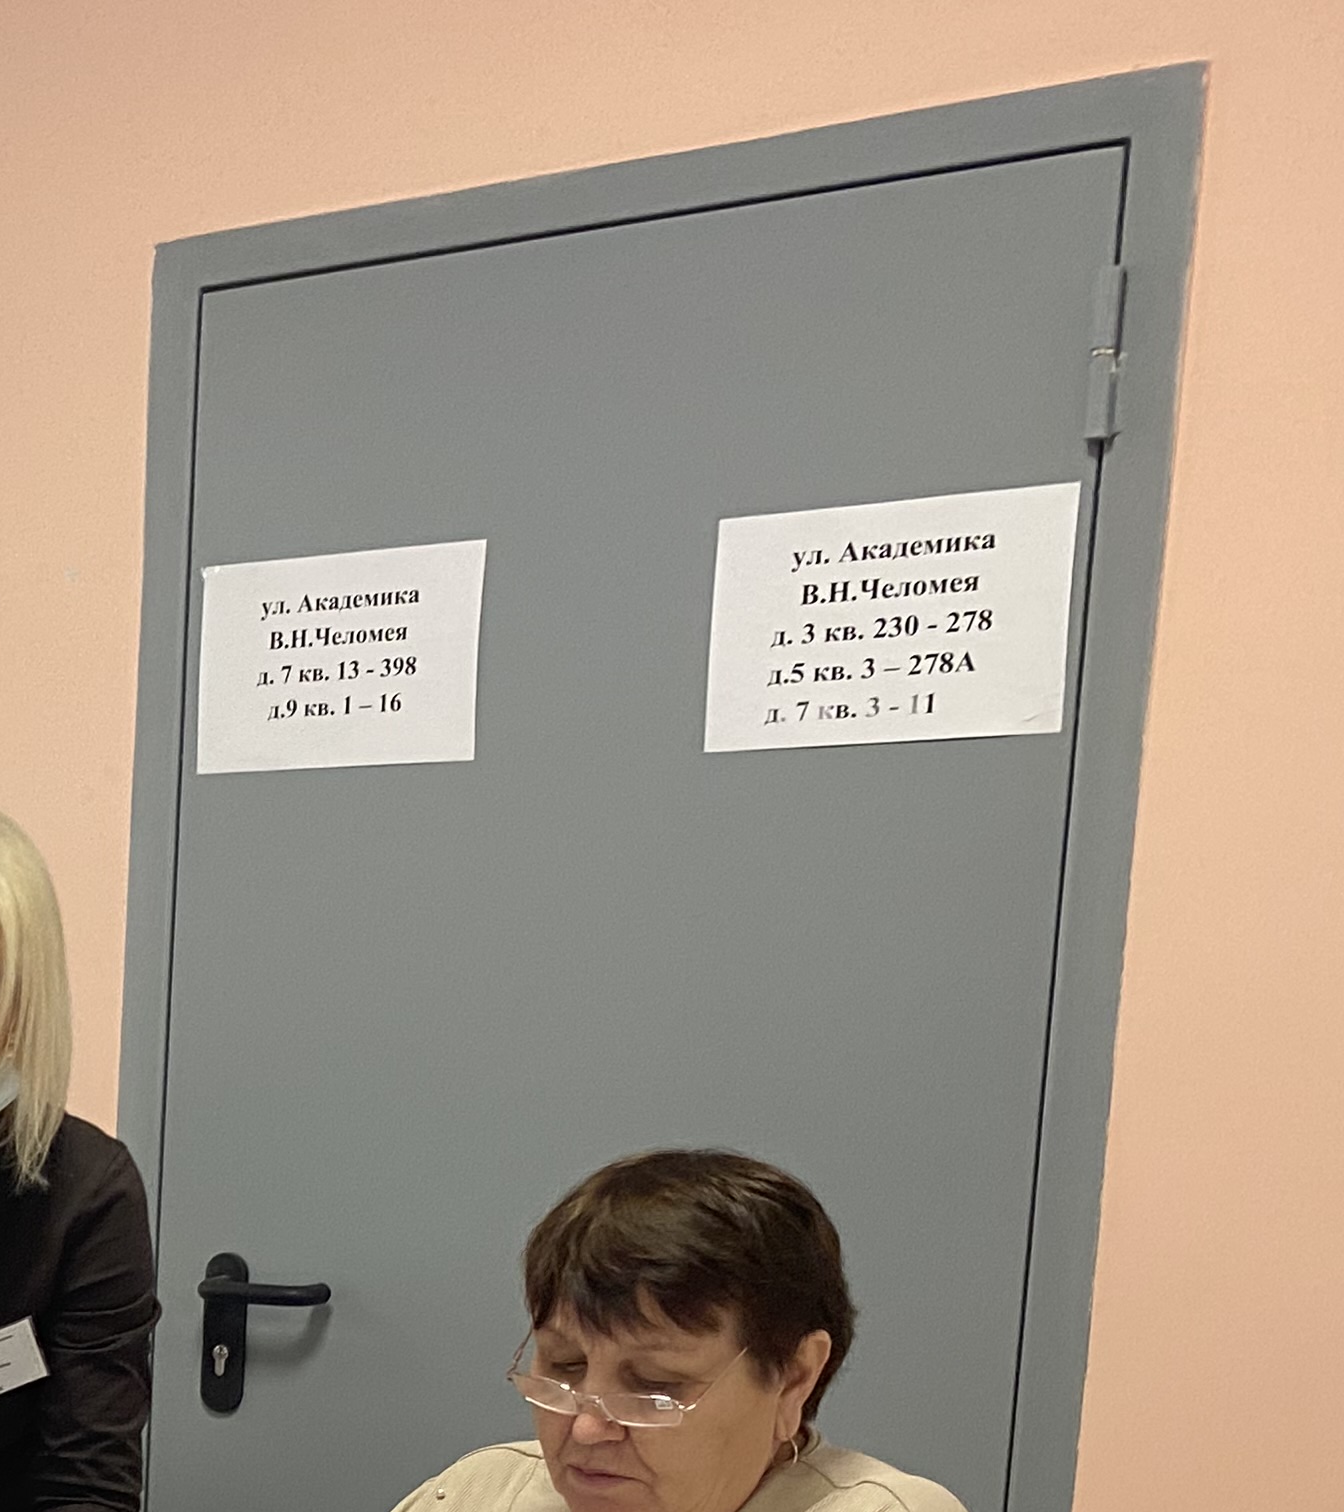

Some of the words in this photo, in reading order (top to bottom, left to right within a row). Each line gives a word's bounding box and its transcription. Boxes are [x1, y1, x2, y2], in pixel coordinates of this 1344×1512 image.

[791, 549, 830, 573] ул.
[838, 534, 996, 563] Академика
[260, 600, 291, 621] ул.
[297, 589, 420, 613] Академика
[801, 575, 979, 606] В.Н.Челомея
[269, 626, 408, 650] В.Н.Челомея
[770, 631, 793, 648] д.
[801, 623, 815, 645] 3
[824, 626, 864, 643] кв.
[873, 614, 919, 639] 230
[945, 609, 993, 634] 278
[256, 671, 274, 687] д.
[281, 664, 292, 684] 7
[298, 668, 330, 683] кв.
[338, 660, 359, 680] 13
[379, 656, 417, 678] 398
[767, 662, 805, 687] д.5
[813, 666, 852, 682] кв.
[860, 657, 875, 679] 3
[907, 651, 975, 676] 278А
[267, 699, 298, 721] д.9
[304, 703, 335, 717] кв.
[344, 695, 351, 715] 1
[380, 692, 402, 713] 16
[763, 708, 786, 726] д.
[796, 700, 810, 722] 7
[818, 704, 857, 720] кв.
[864, 696, 880, 718] 3
[911, 692, 935, 714] 11
